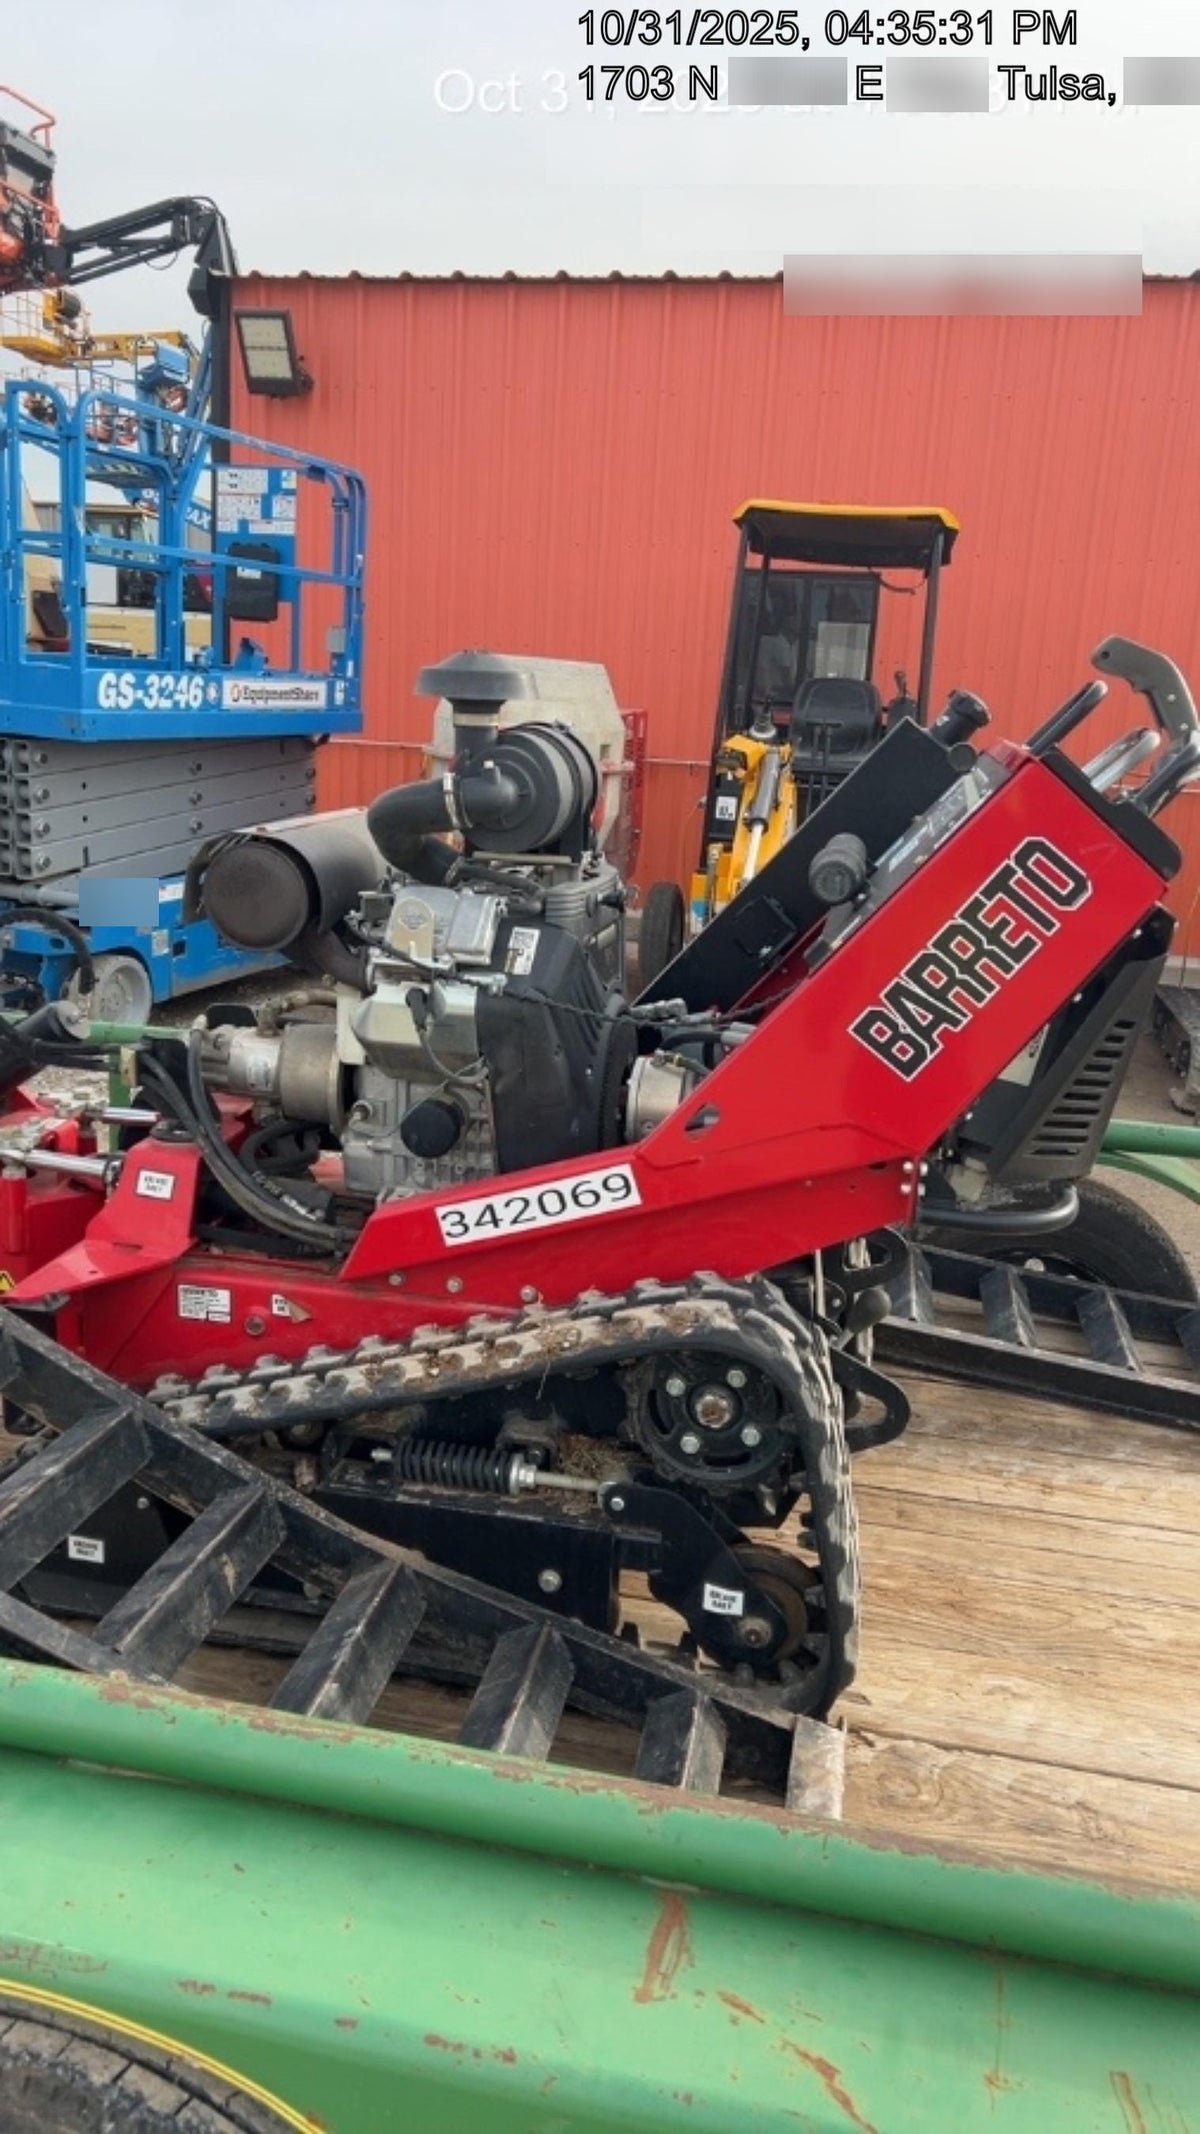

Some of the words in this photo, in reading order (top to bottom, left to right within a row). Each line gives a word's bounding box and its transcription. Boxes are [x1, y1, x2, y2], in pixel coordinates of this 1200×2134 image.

[97, 671, 205, 710] GS-3246
[847, 836, 1093, 1082] BARRETO
[440, 1173, 632, 1238] 342069
